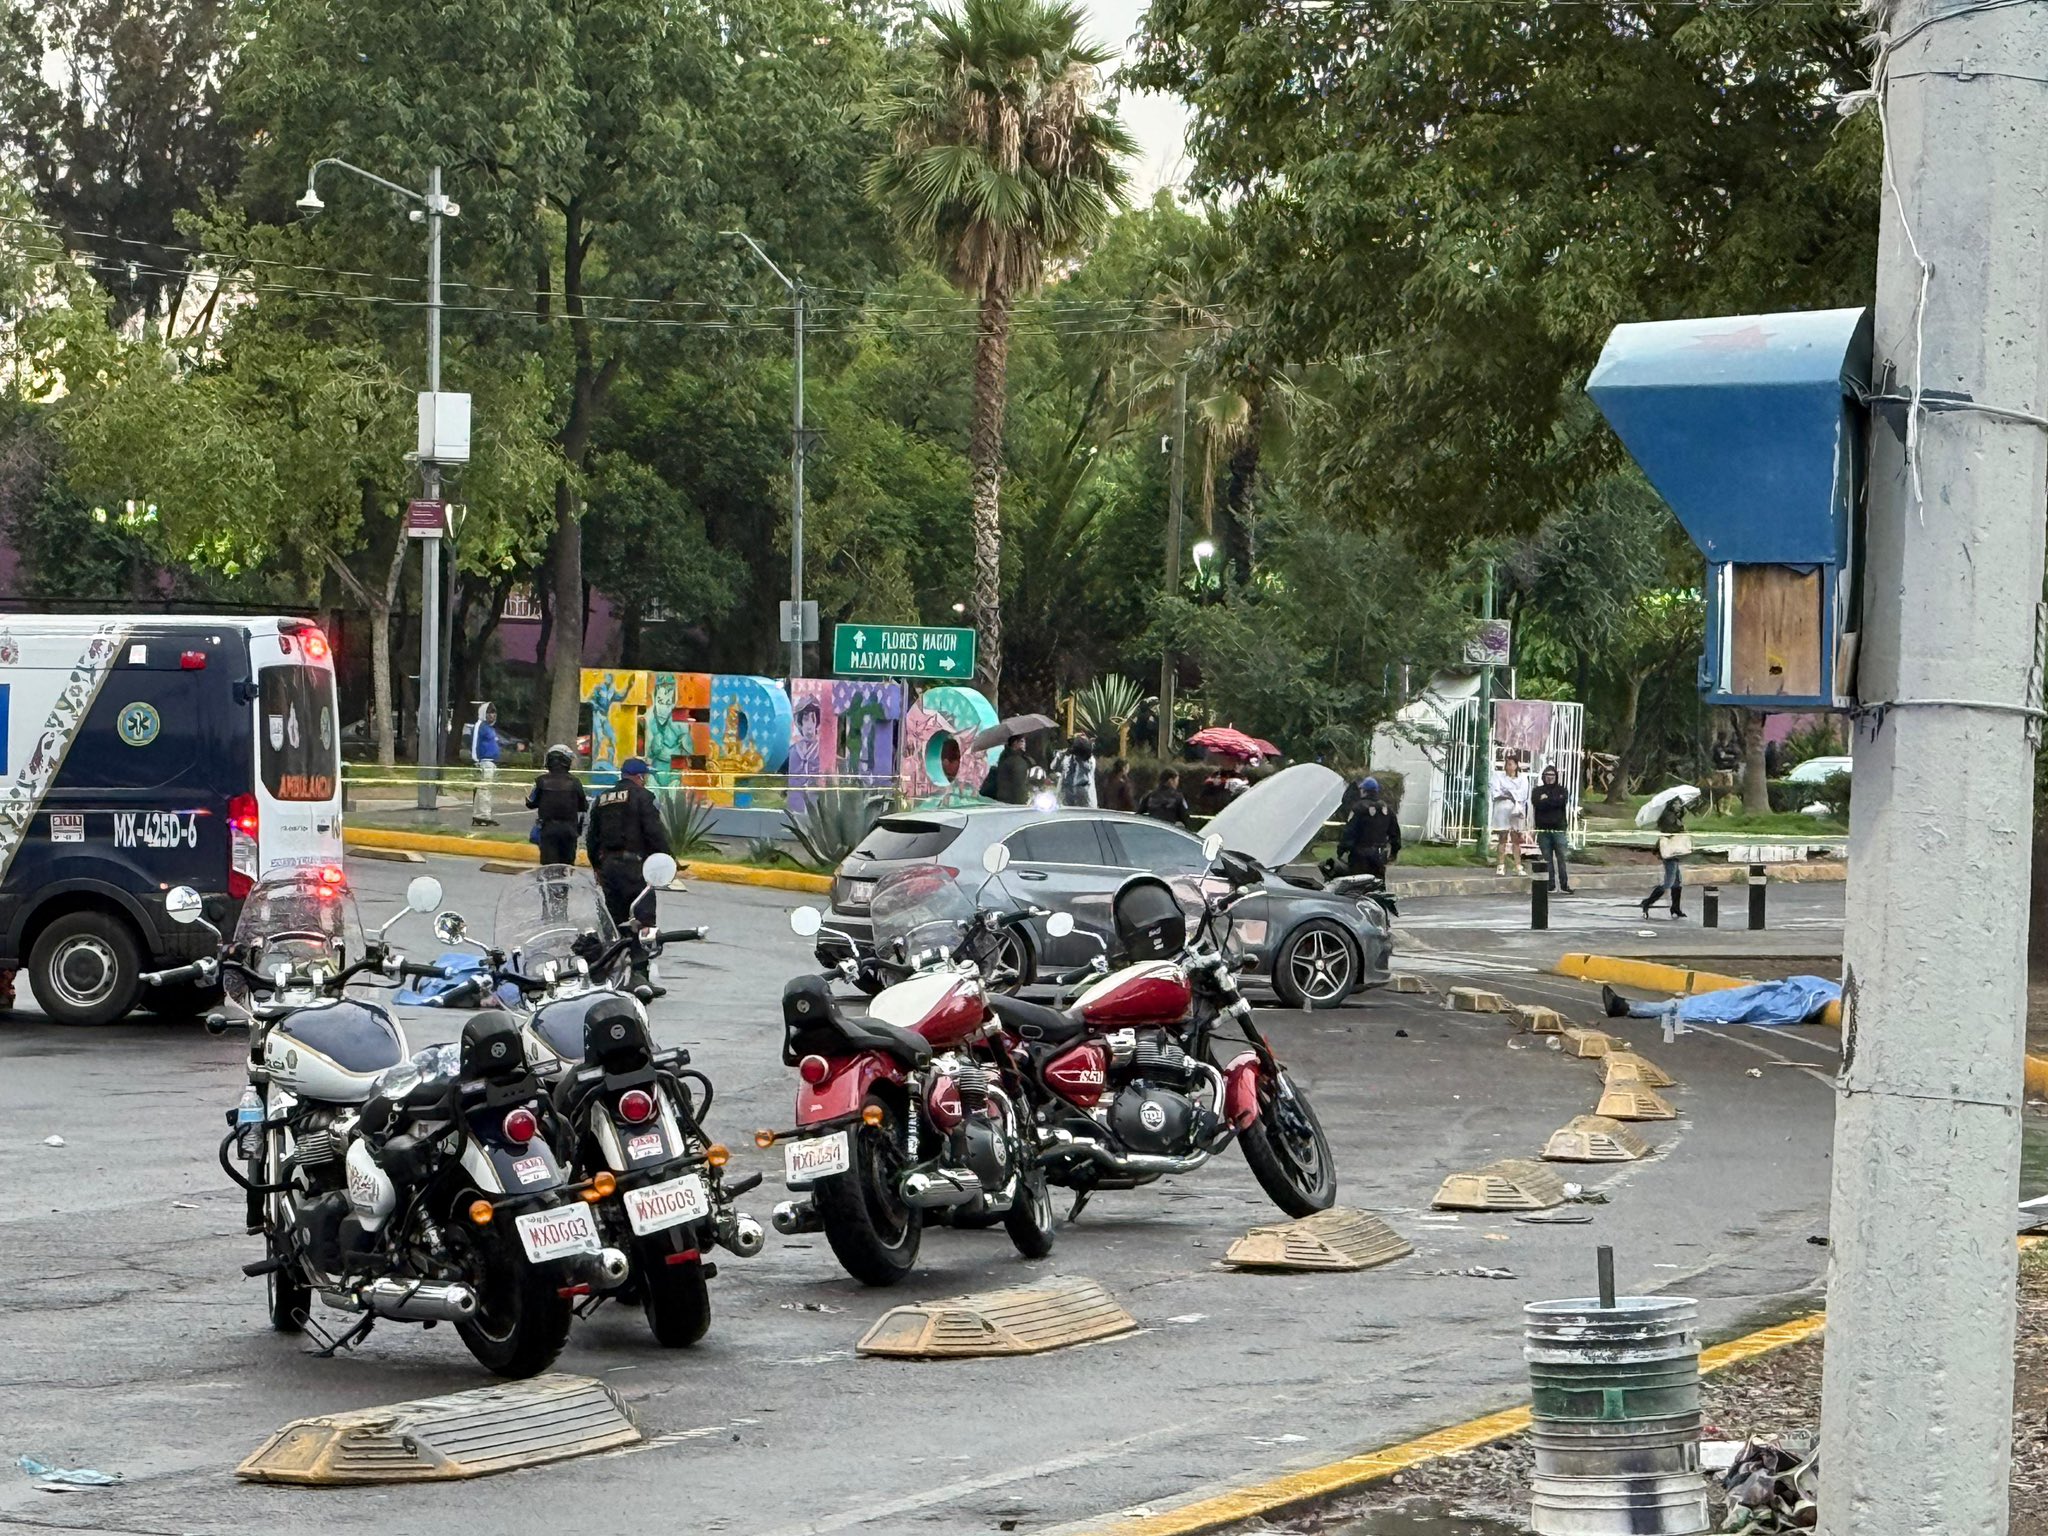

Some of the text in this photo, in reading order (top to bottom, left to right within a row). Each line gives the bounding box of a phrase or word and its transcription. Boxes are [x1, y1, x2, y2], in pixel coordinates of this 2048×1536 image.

[881, 631, 919, 650] FLORES
[850, 651, 925, 671] MATAMOROS
[114, 813, 197, 848] MX-425D-6
